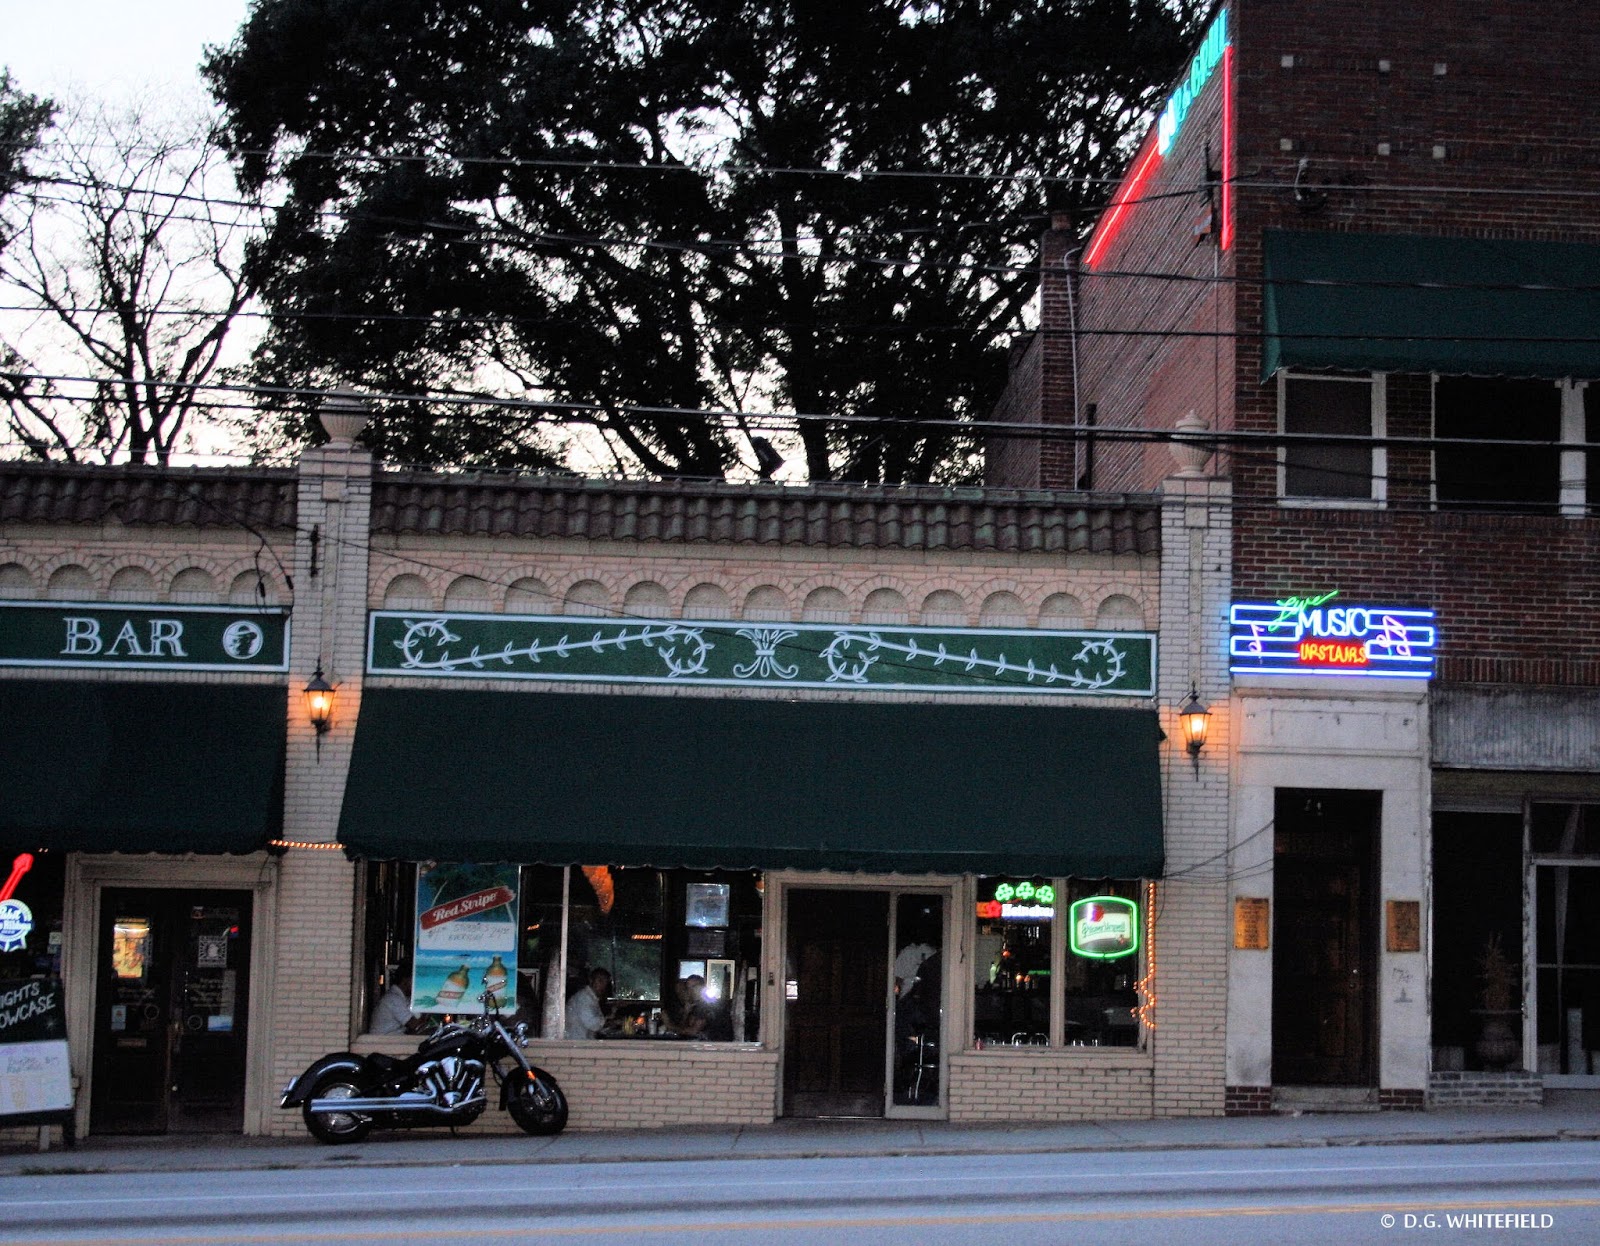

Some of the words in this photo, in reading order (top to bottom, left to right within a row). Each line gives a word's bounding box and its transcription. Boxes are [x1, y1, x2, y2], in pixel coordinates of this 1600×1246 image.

[1267, 589, 1339, 632] Live
[1298, 608, 1369, 637] MUSIC
[60, 616, 189, 657] BAR
[432, 905, 459, 922] Red
[460, 891, 498, 913] Stripe
